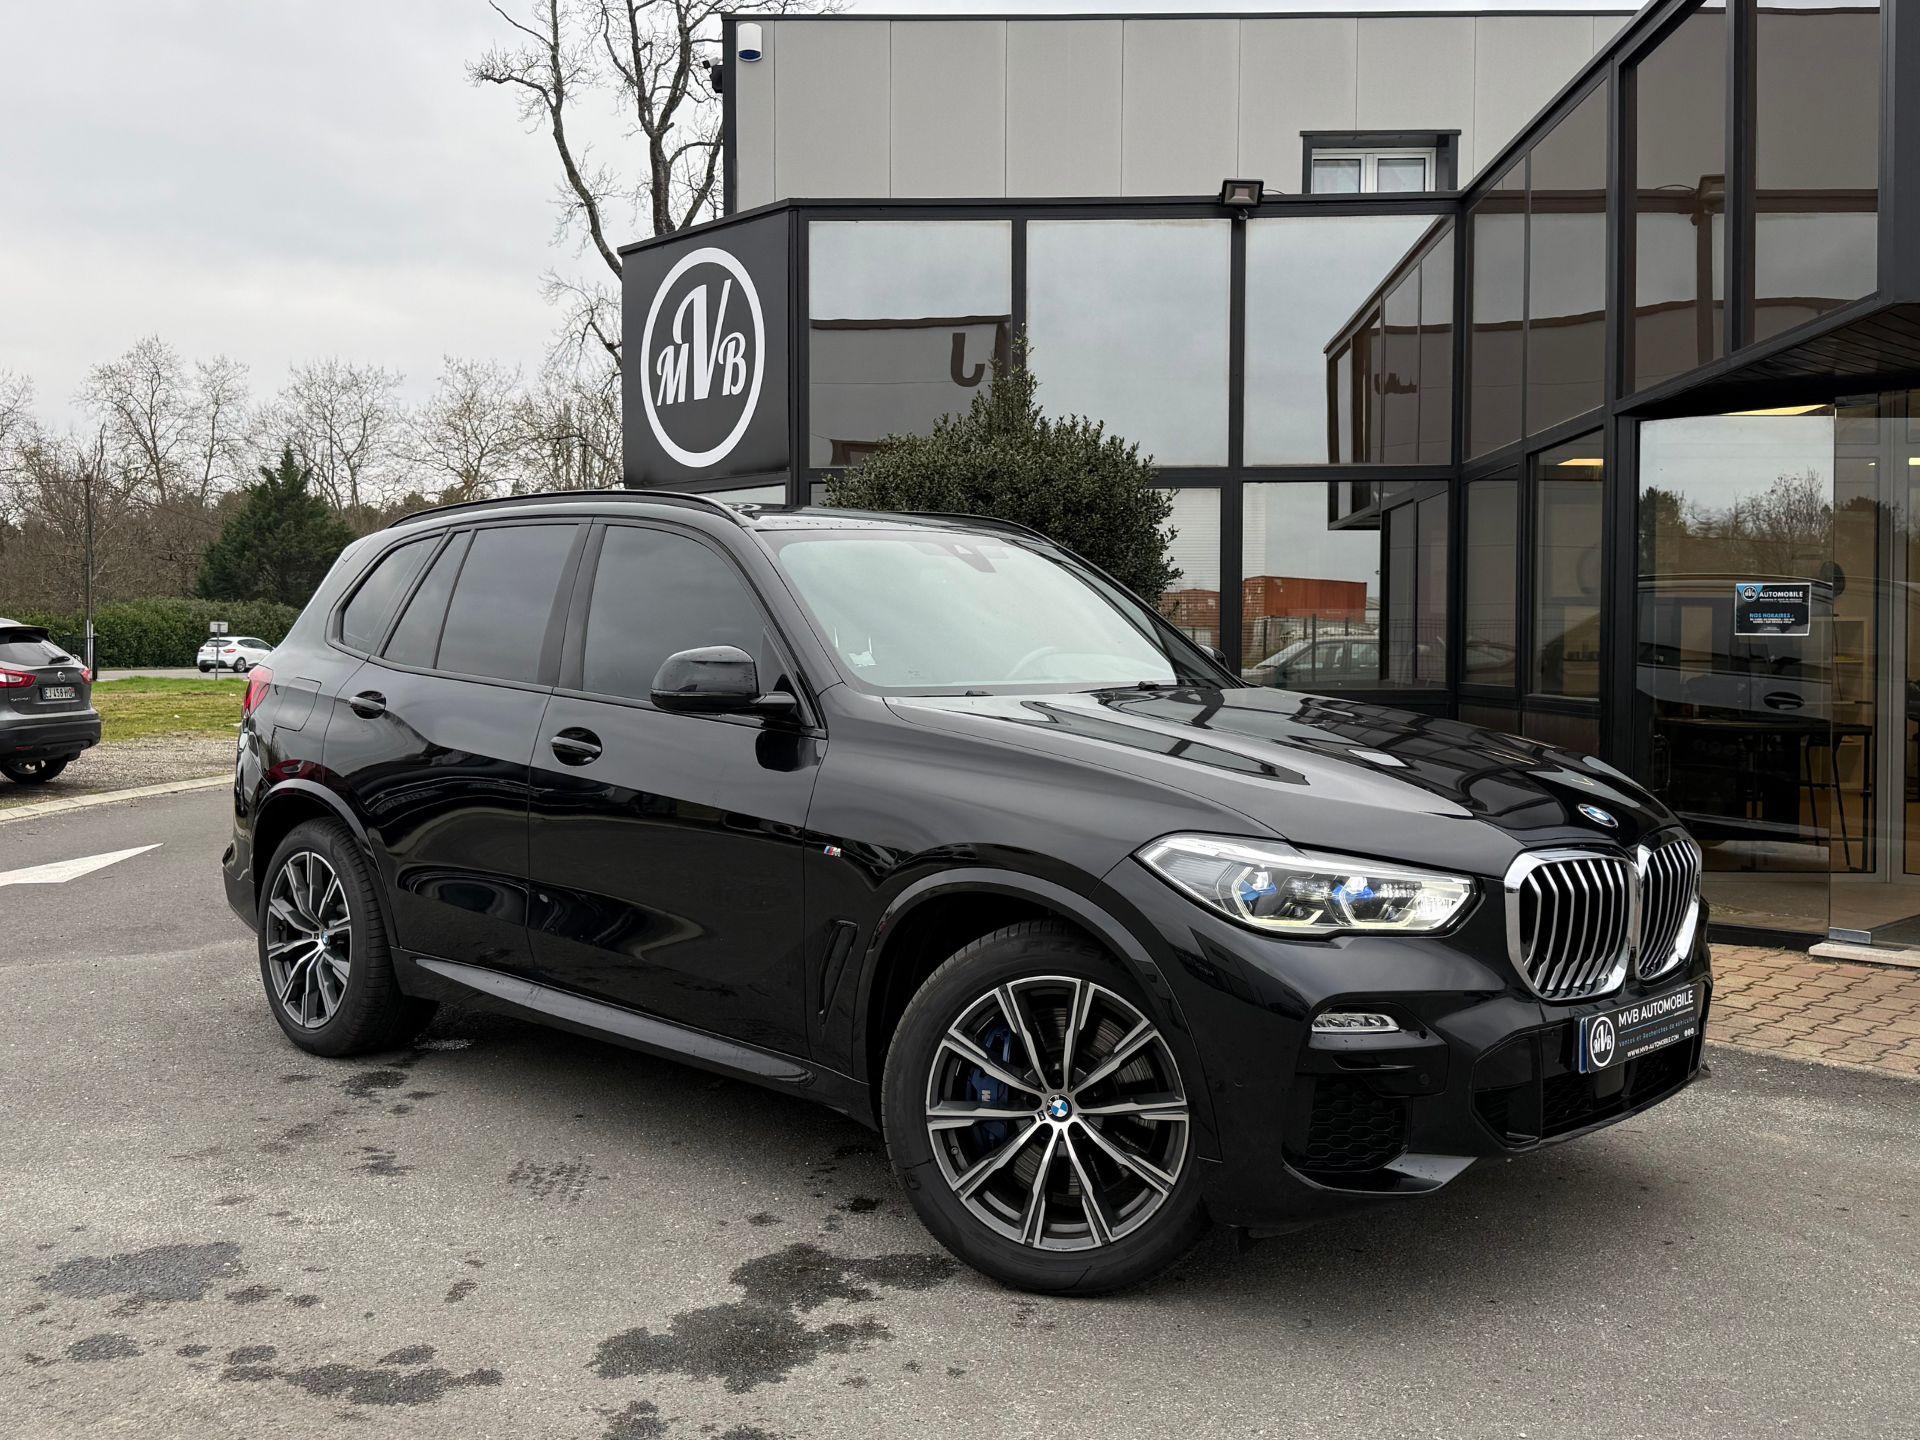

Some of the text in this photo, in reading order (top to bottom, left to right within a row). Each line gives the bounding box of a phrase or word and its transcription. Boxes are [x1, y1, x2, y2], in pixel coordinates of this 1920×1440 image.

[656, 279, 746, 406] MVB
[1618, 990, 1694, 1027] MVB AUTOMOBILE
